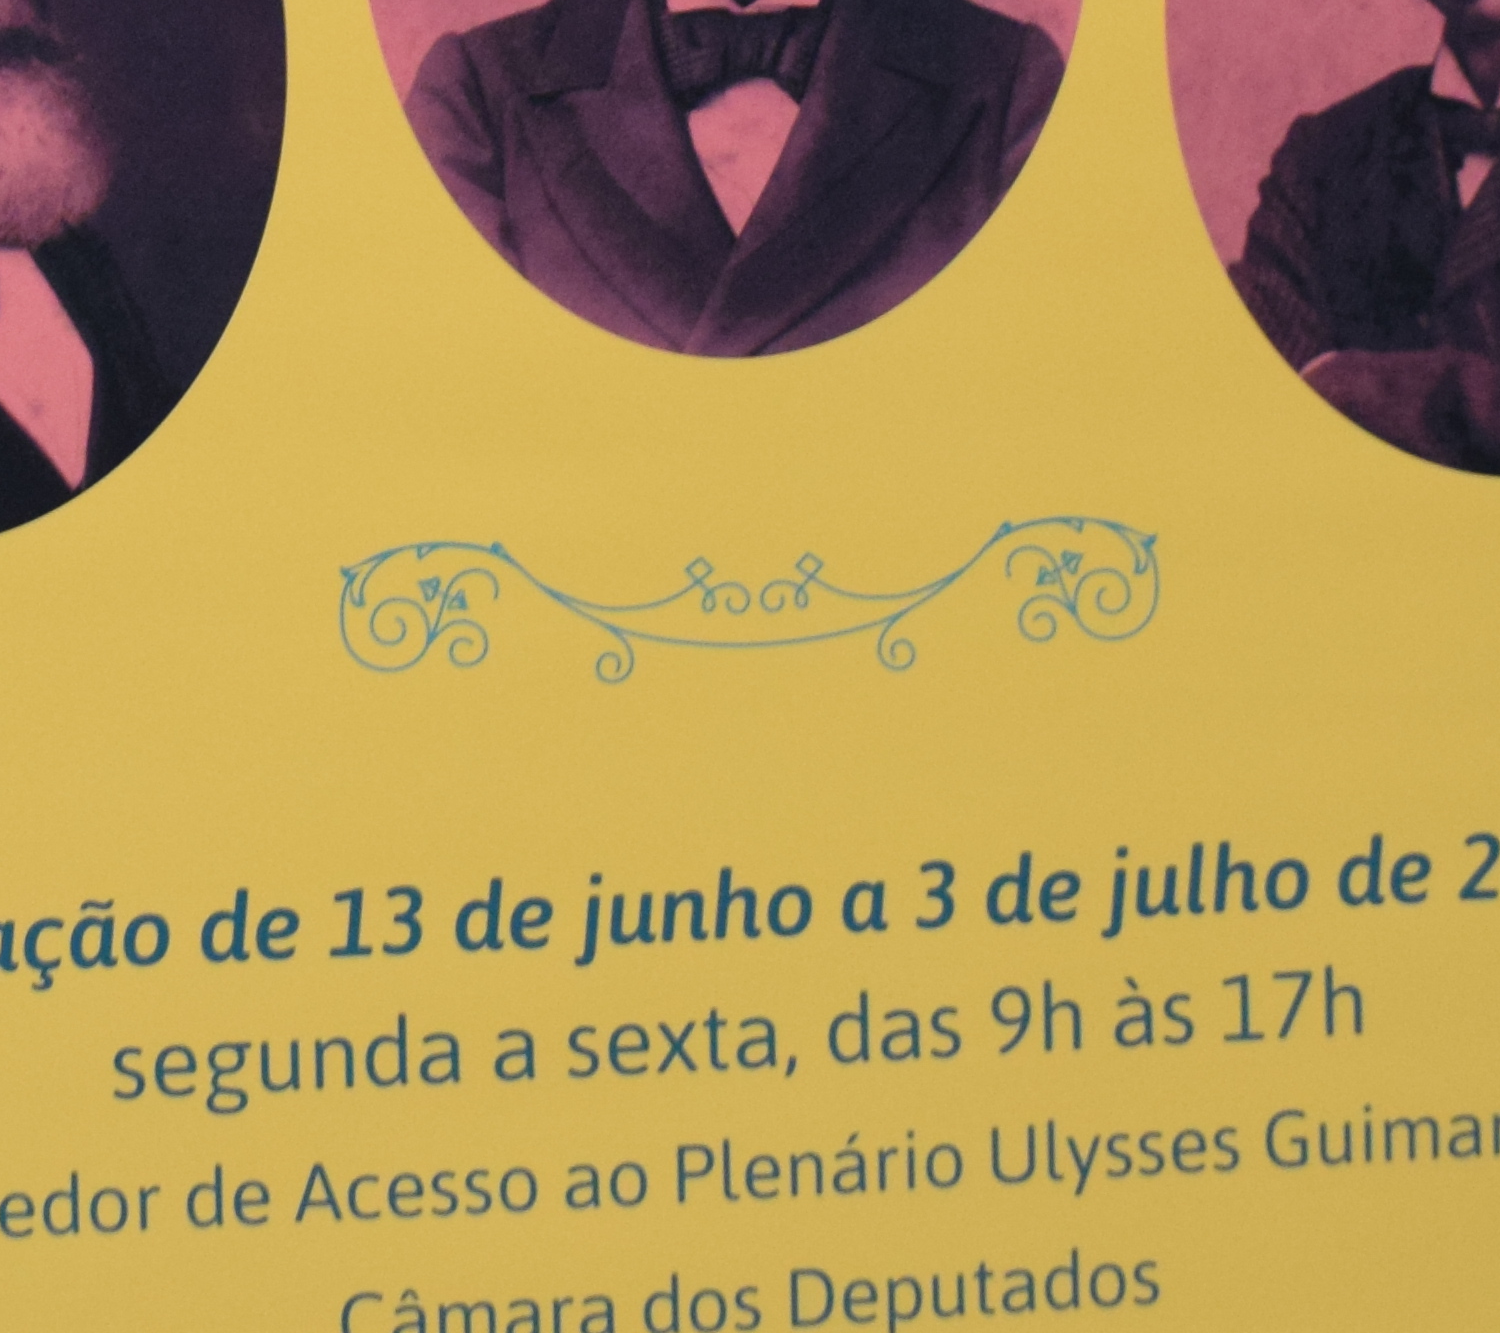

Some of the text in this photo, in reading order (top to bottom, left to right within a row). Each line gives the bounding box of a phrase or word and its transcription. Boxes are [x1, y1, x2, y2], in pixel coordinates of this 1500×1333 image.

[198, 885, 303, 967] de
[326, 882, 426, 961] 13
[452, 874, 557, 956] de
[571, 863, 816, 971] junho
[839, 878, 891, 937] a
[913, 857, 958, 934] 3
[983, 849, 1084, 928] de
[1098, 838, 1313, 943] julho
[1335, 831, 1434, 910] de
[110, 962, 1366, 1119] segunda a sexta, das 9h às 17h
[183, 1162, 273, 1231] de
[293, 1160, 541, 1225] Acesso
[562, 1159, 651, 1213] ao
[674, 1128, 966, 1207] Plenário
[988, 1117, 1243, 1199] Ulysses
[640, 1271, 764, 1333] dos
[787, 1246, 1163, 1333] Deputados
